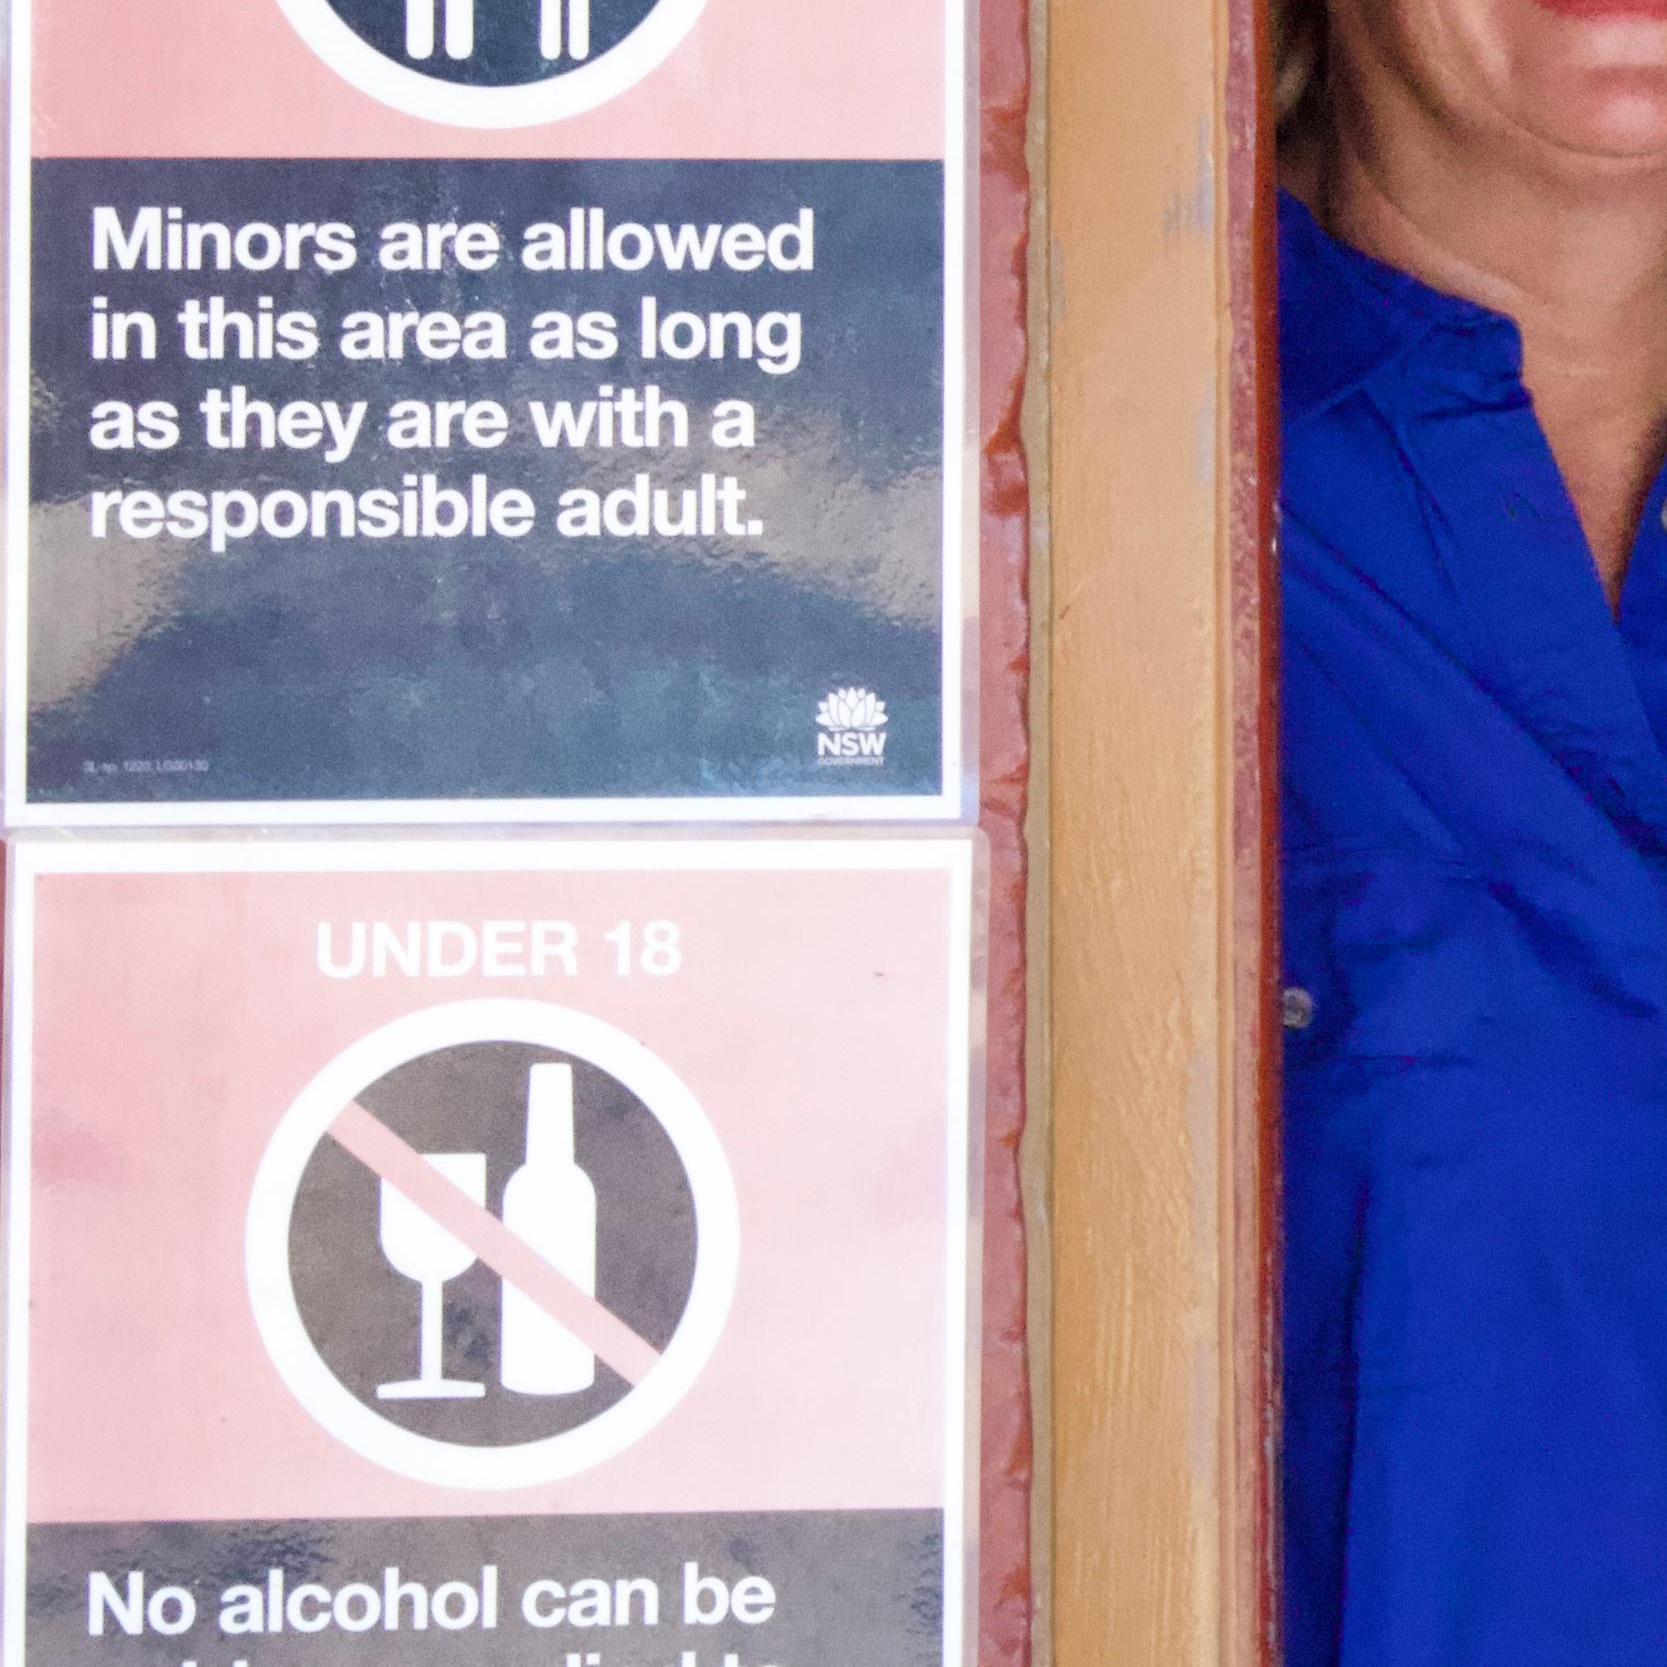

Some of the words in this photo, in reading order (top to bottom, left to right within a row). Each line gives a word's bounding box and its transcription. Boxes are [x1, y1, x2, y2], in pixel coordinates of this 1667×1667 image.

[94, 207, 357, 273] Minors
[379, 222, 500, 270] are
[522, 208, 813, 271] allowed
[93, 296, 156, 359] in
[178, 296, 320, 359] this
[340, 311, 506, 359] area
[530, 311, 618, 359] as
[641, 296, 801, 375] long
[90, 401, 179, 449] as
[200, 386, 367, 463] they
[387, 401, 508, 448] are
[529, 385, 688, 448] with
[710, 400, 755, 448] a
[90, 473, 535, 553] responsible
[557, 473, 763, 536] adult.
[818, 731, 886, 757] NSW
[318, 920, 578, 978] UNDER
[605, 920, 682, 976] 18
[88, 1571, 196, 1636] No
[220, 1565, 497, 1634] alcohol
[522, 1578, 658, 1627] can
[684, 1562, 776, 1625] be
